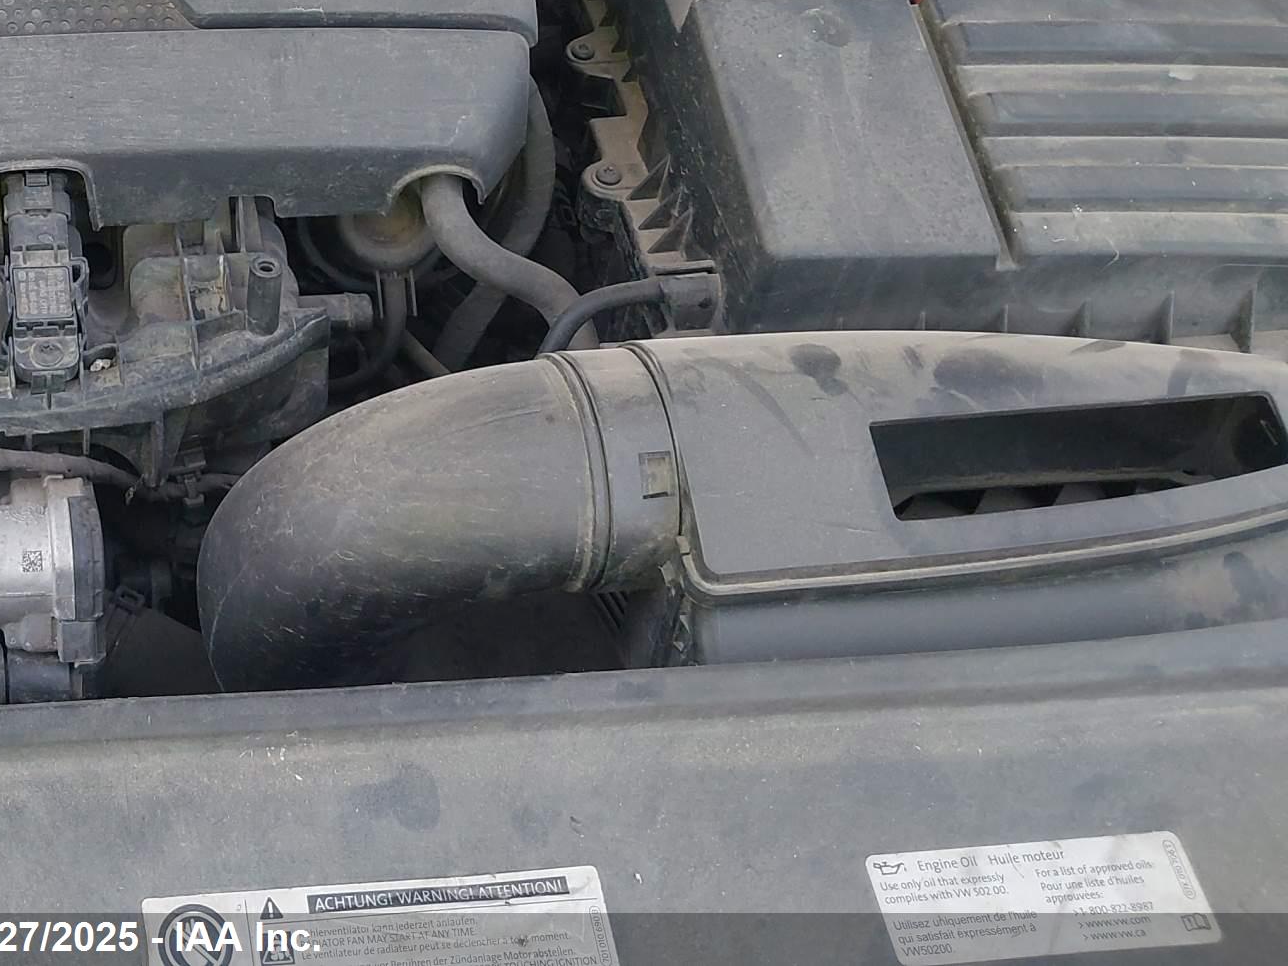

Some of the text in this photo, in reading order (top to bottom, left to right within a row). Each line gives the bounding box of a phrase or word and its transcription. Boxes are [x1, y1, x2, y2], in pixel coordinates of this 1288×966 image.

[917, 855, 978, 873] Engine Oil
[987, 849, 1065, 866] Huile moteur
[1035, 868, 1052, 878] For
[1060, 865, 1076, 876] list
[1078, 864, 1087, 874] of
[1090, 861, 1134, 875] approved
[880, 872, 1005, 891] Use only oil that expressly
[1040, 874, 1144, 891] Pour une liste d'huiles
[314, 879, 563, 912] ACHTUNG! WARNING! ATTENTION!
[885, 892, 928, 905] complies
[930, 889, 953, 901] with
[954, 888, 971, 898] VW
[371, 923, 394, 933] kann
[396, 920, 434, 932] jederzeit
[893, 909, 1038, 931] Utilisez uniquement de l'huile
[347, 936, 365, 945] FAN
[367, 934, 387, 944] MAY
[389, 932, 415, 943] START
[417, 931, 430, 940] AT
[431, 929, 450, 938] ANY
[898, 933, 914, 945] qui
[916, 929, 955, 941] satisfait
[313, 948, 361, 960] ventilateur
[364, 945, 375, 955] de
[376, 943, 417, 954] radiateur
[419, 941, 440, 953] peut
[441, 940, 451, 949] se
[433, 956, 448, 966] der
[450, 952, 503, 965] Zündanlage
[503, 950, 532, 961] Motor
